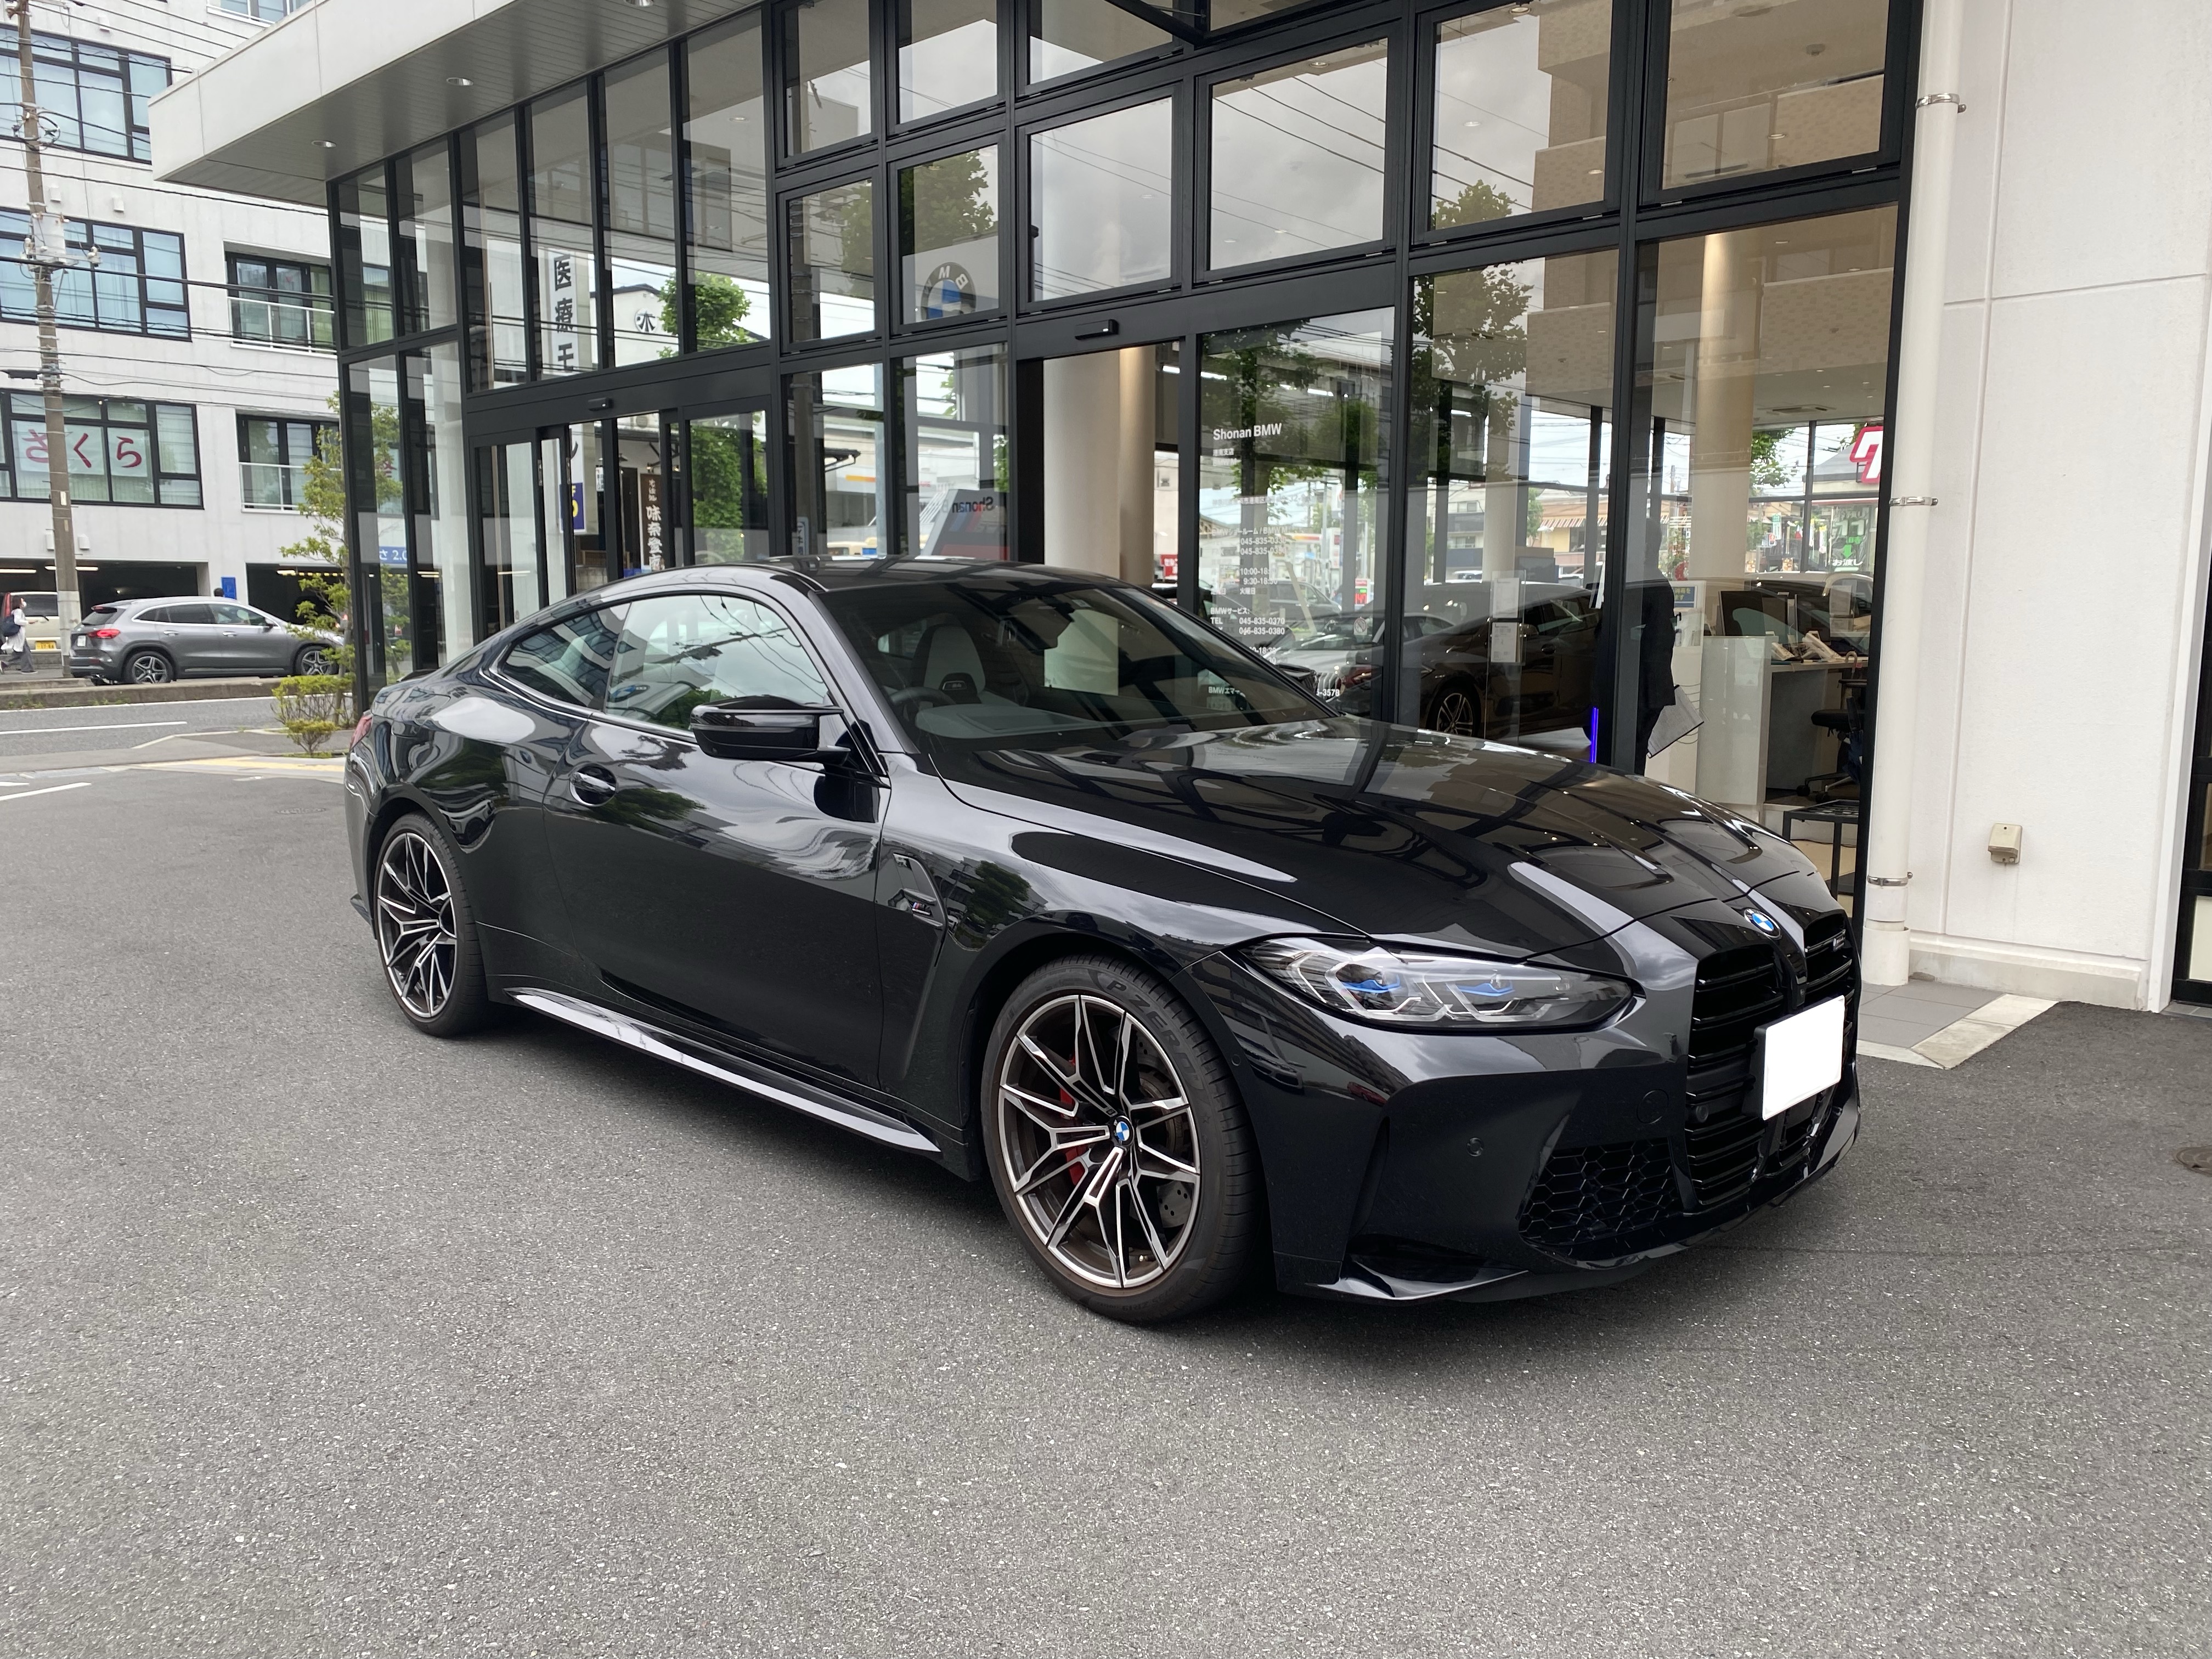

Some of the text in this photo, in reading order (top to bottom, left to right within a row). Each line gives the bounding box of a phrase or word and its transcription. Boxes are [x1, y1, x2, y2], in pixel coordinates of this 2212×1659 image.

[22, 429, 142, 468] さくら
[1213, 423, 1282, 440] Shonan BMW
[1107, 980, 1196, 1074] P ZERO
